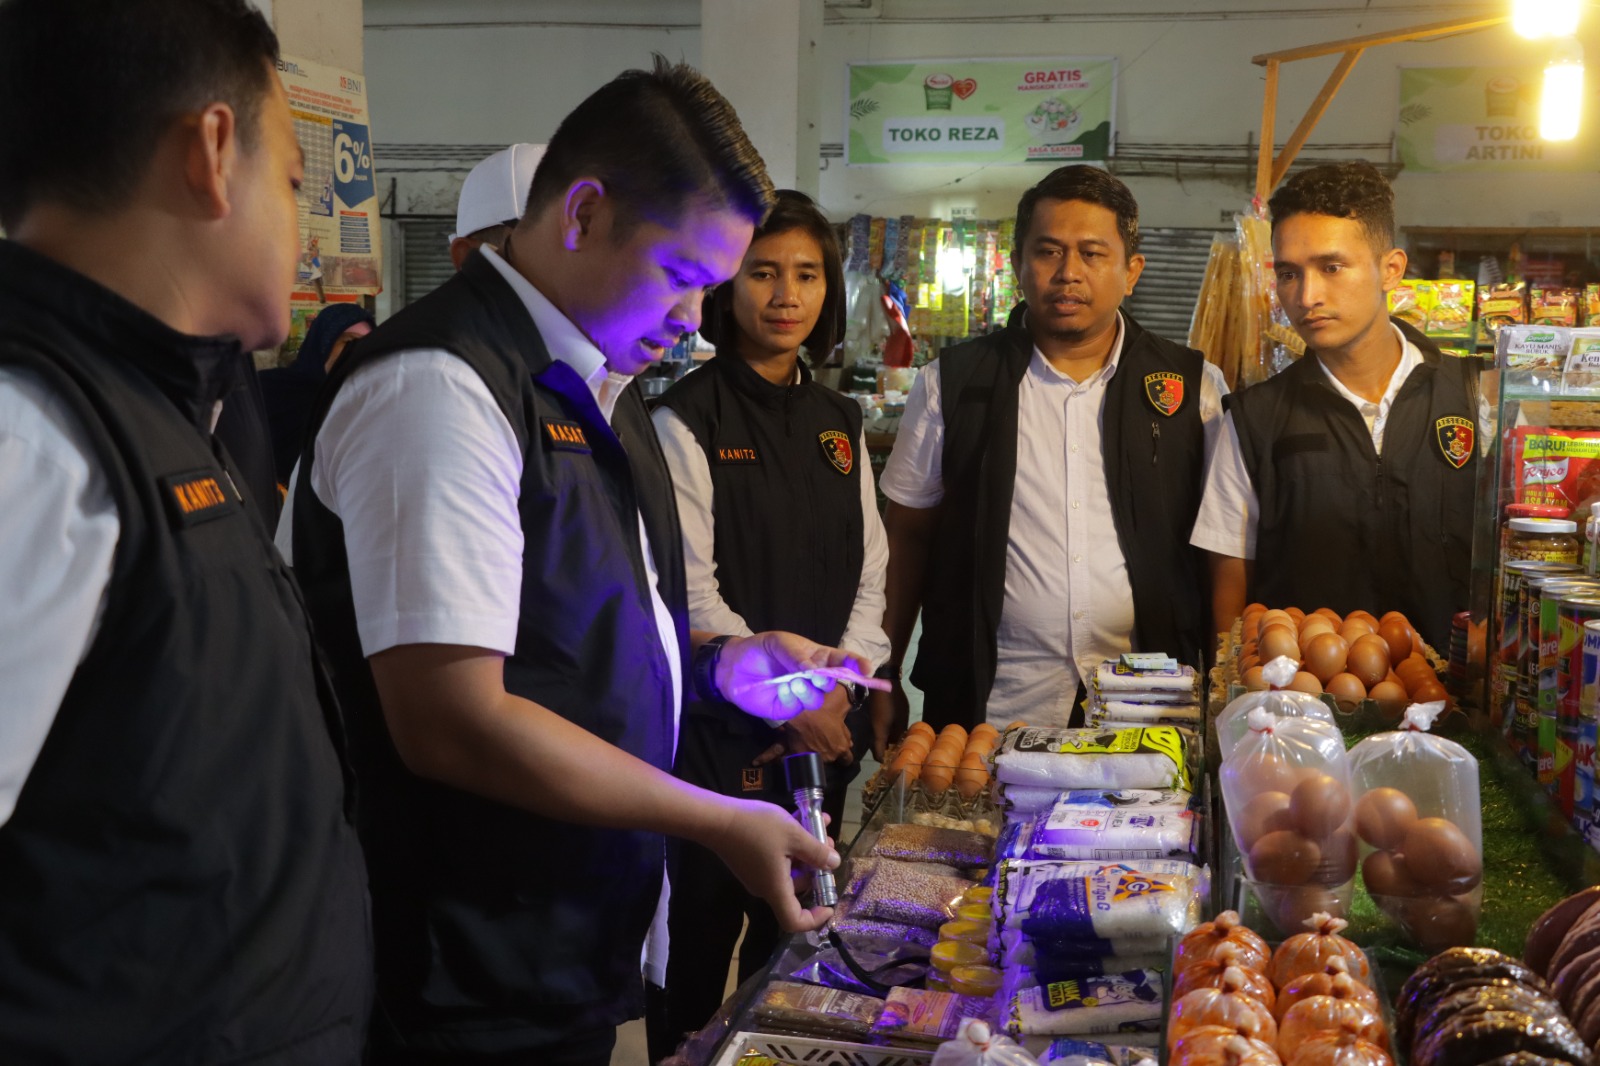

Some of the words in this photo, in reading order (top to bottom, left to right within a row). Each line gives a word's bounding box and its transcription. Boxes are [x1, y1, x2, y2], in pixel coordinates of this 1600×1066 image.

[1024, 70, 1082, 83] GRATIS
[347, 78, 362, 93] BNI
[888, 127, 942, 142] TOKO
[947, 126, 1000, 141] REZA
[334, 133, 370, 184] 6%
[1465, 145, 1544, 161] ARTINI
[1581, 353, 1600, 363] Ken
[547, 423, 586, 444] KASAT
[1529, 438, 1566, 452] BARU!
[719, 447, 755, 461] KANIT2
